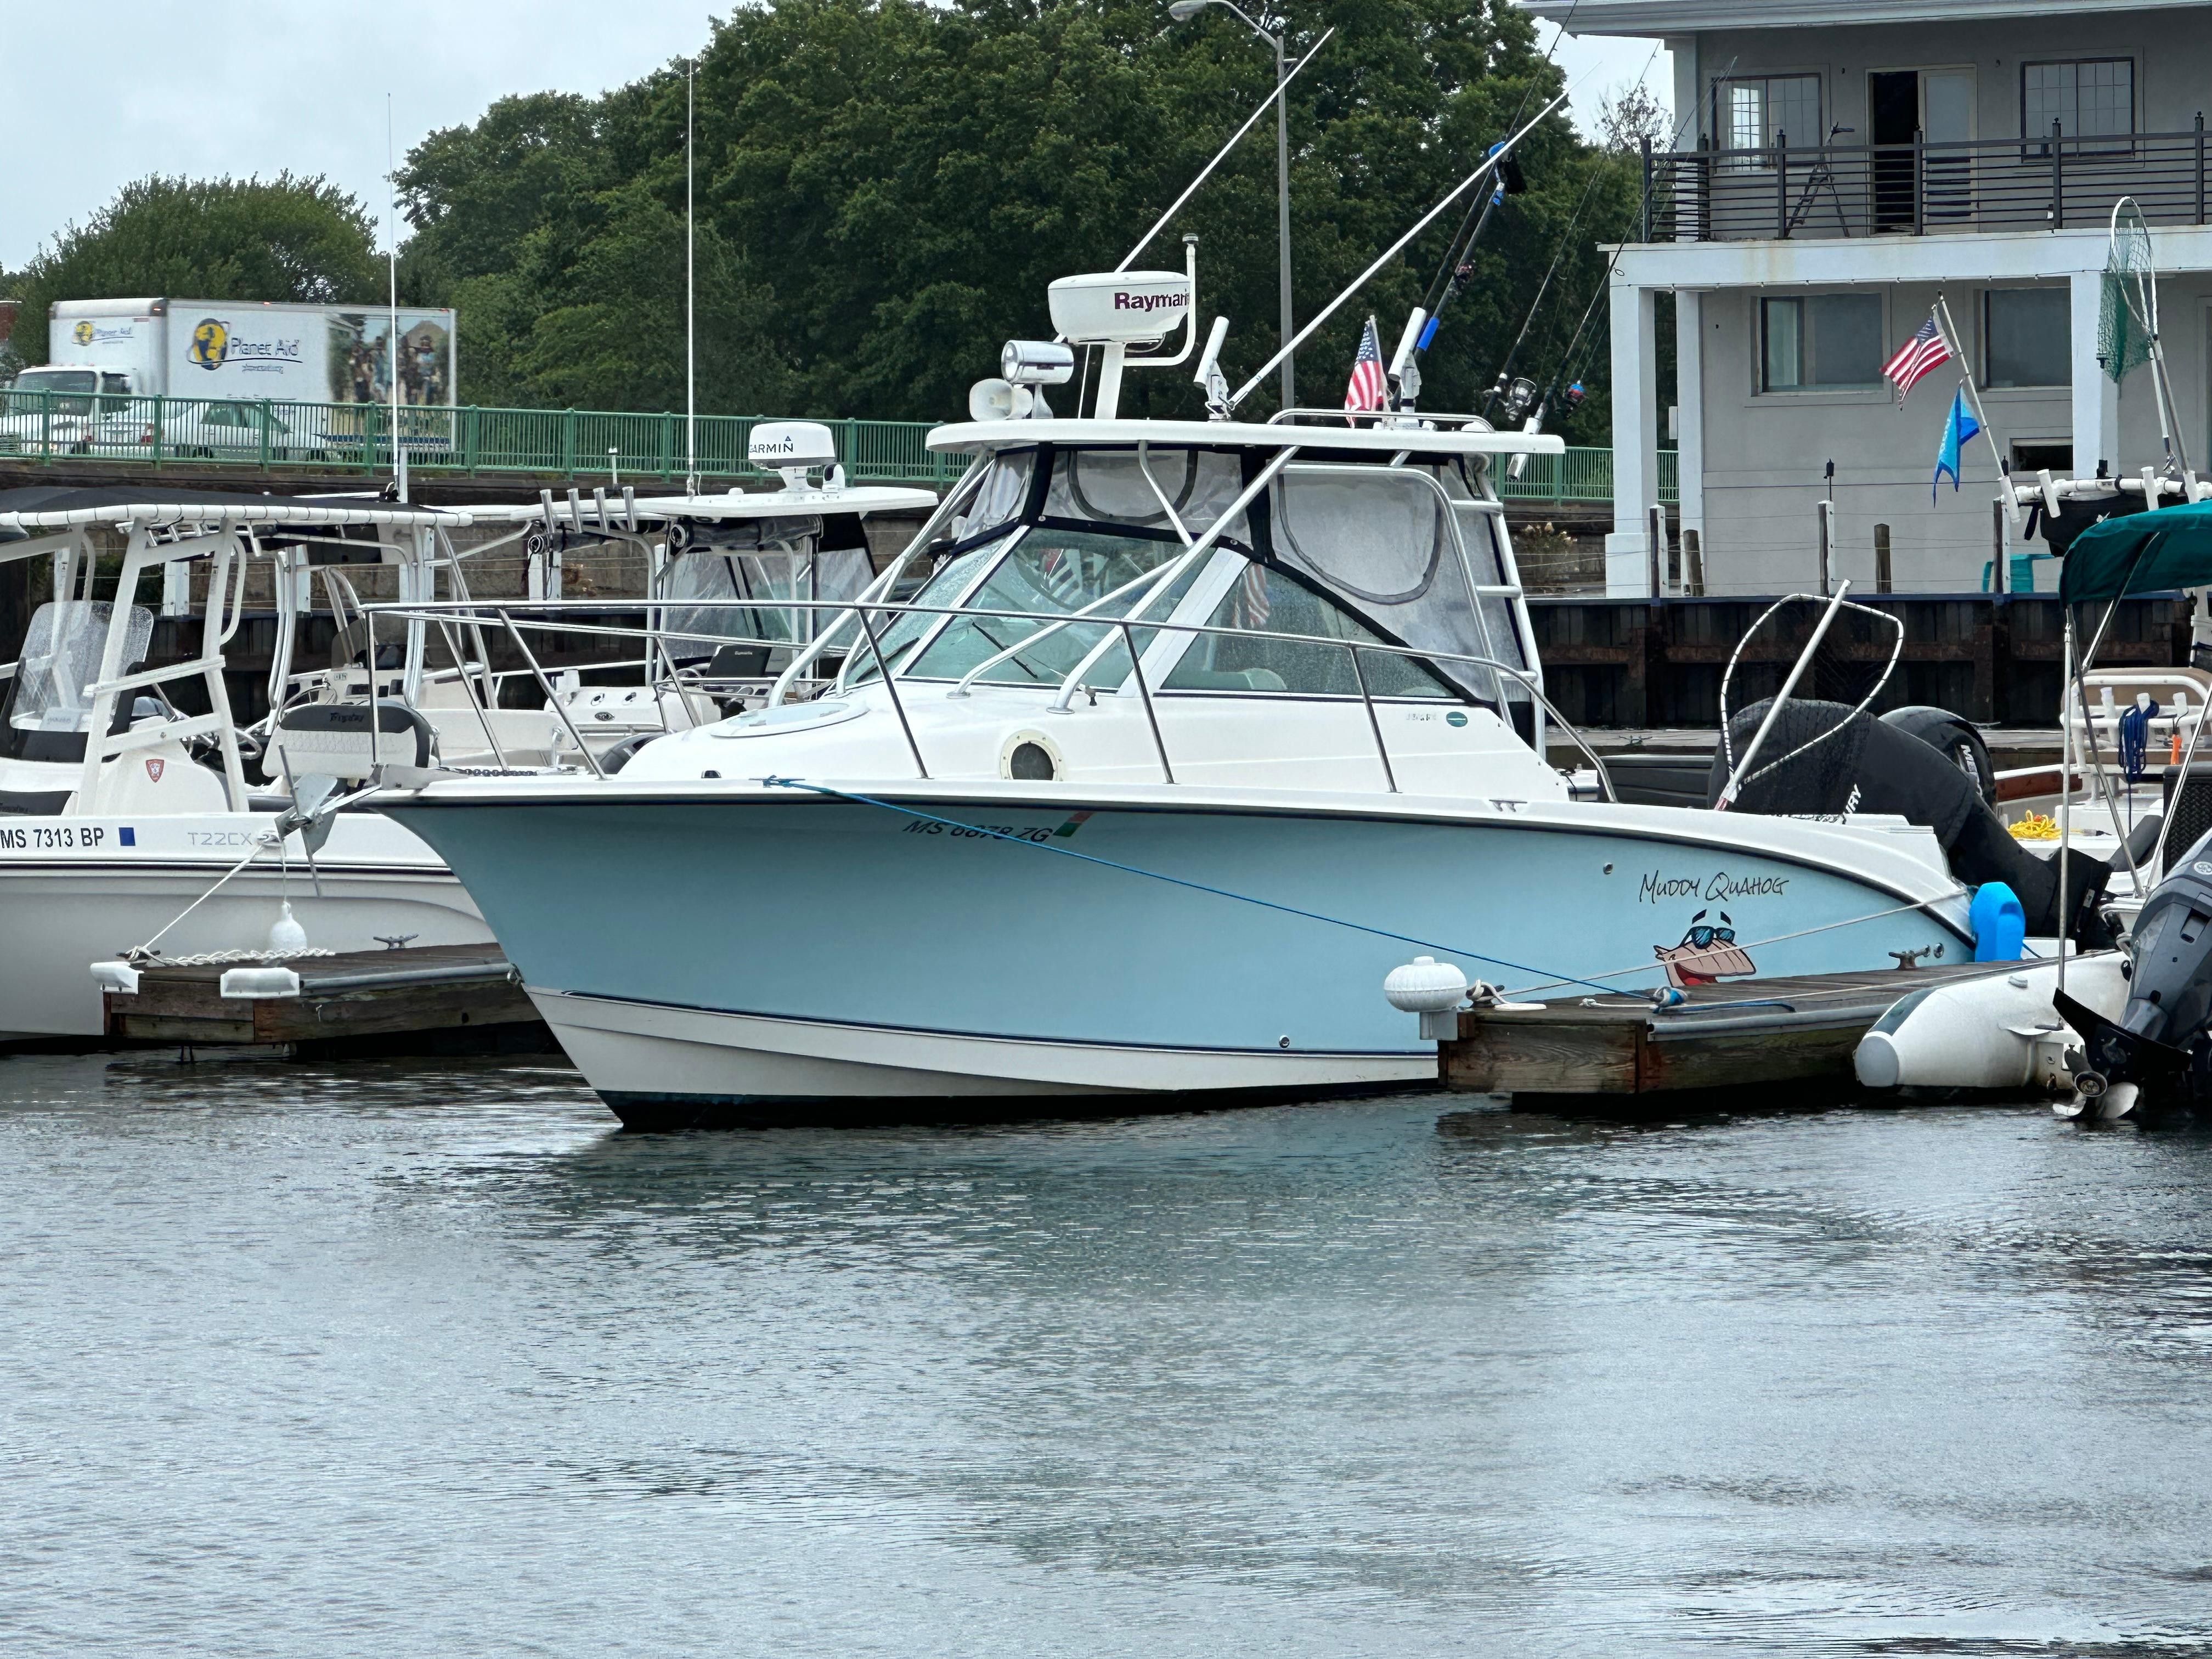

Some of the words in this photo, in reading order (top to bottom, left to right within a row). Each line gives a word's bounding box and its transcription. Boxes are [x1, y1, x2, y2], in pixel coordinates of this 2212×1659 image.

[0, 829, 26, 848] MS
[33, 828, 74, 848] 7313
[81, 827, 104, 847] BP
[188, 832, 253, 845] T22CX
[902, 821, 949, 834] MS
[1015, 827, 1053, 842] ZG
[1705, 871, 1790, 902] QUAHOG
